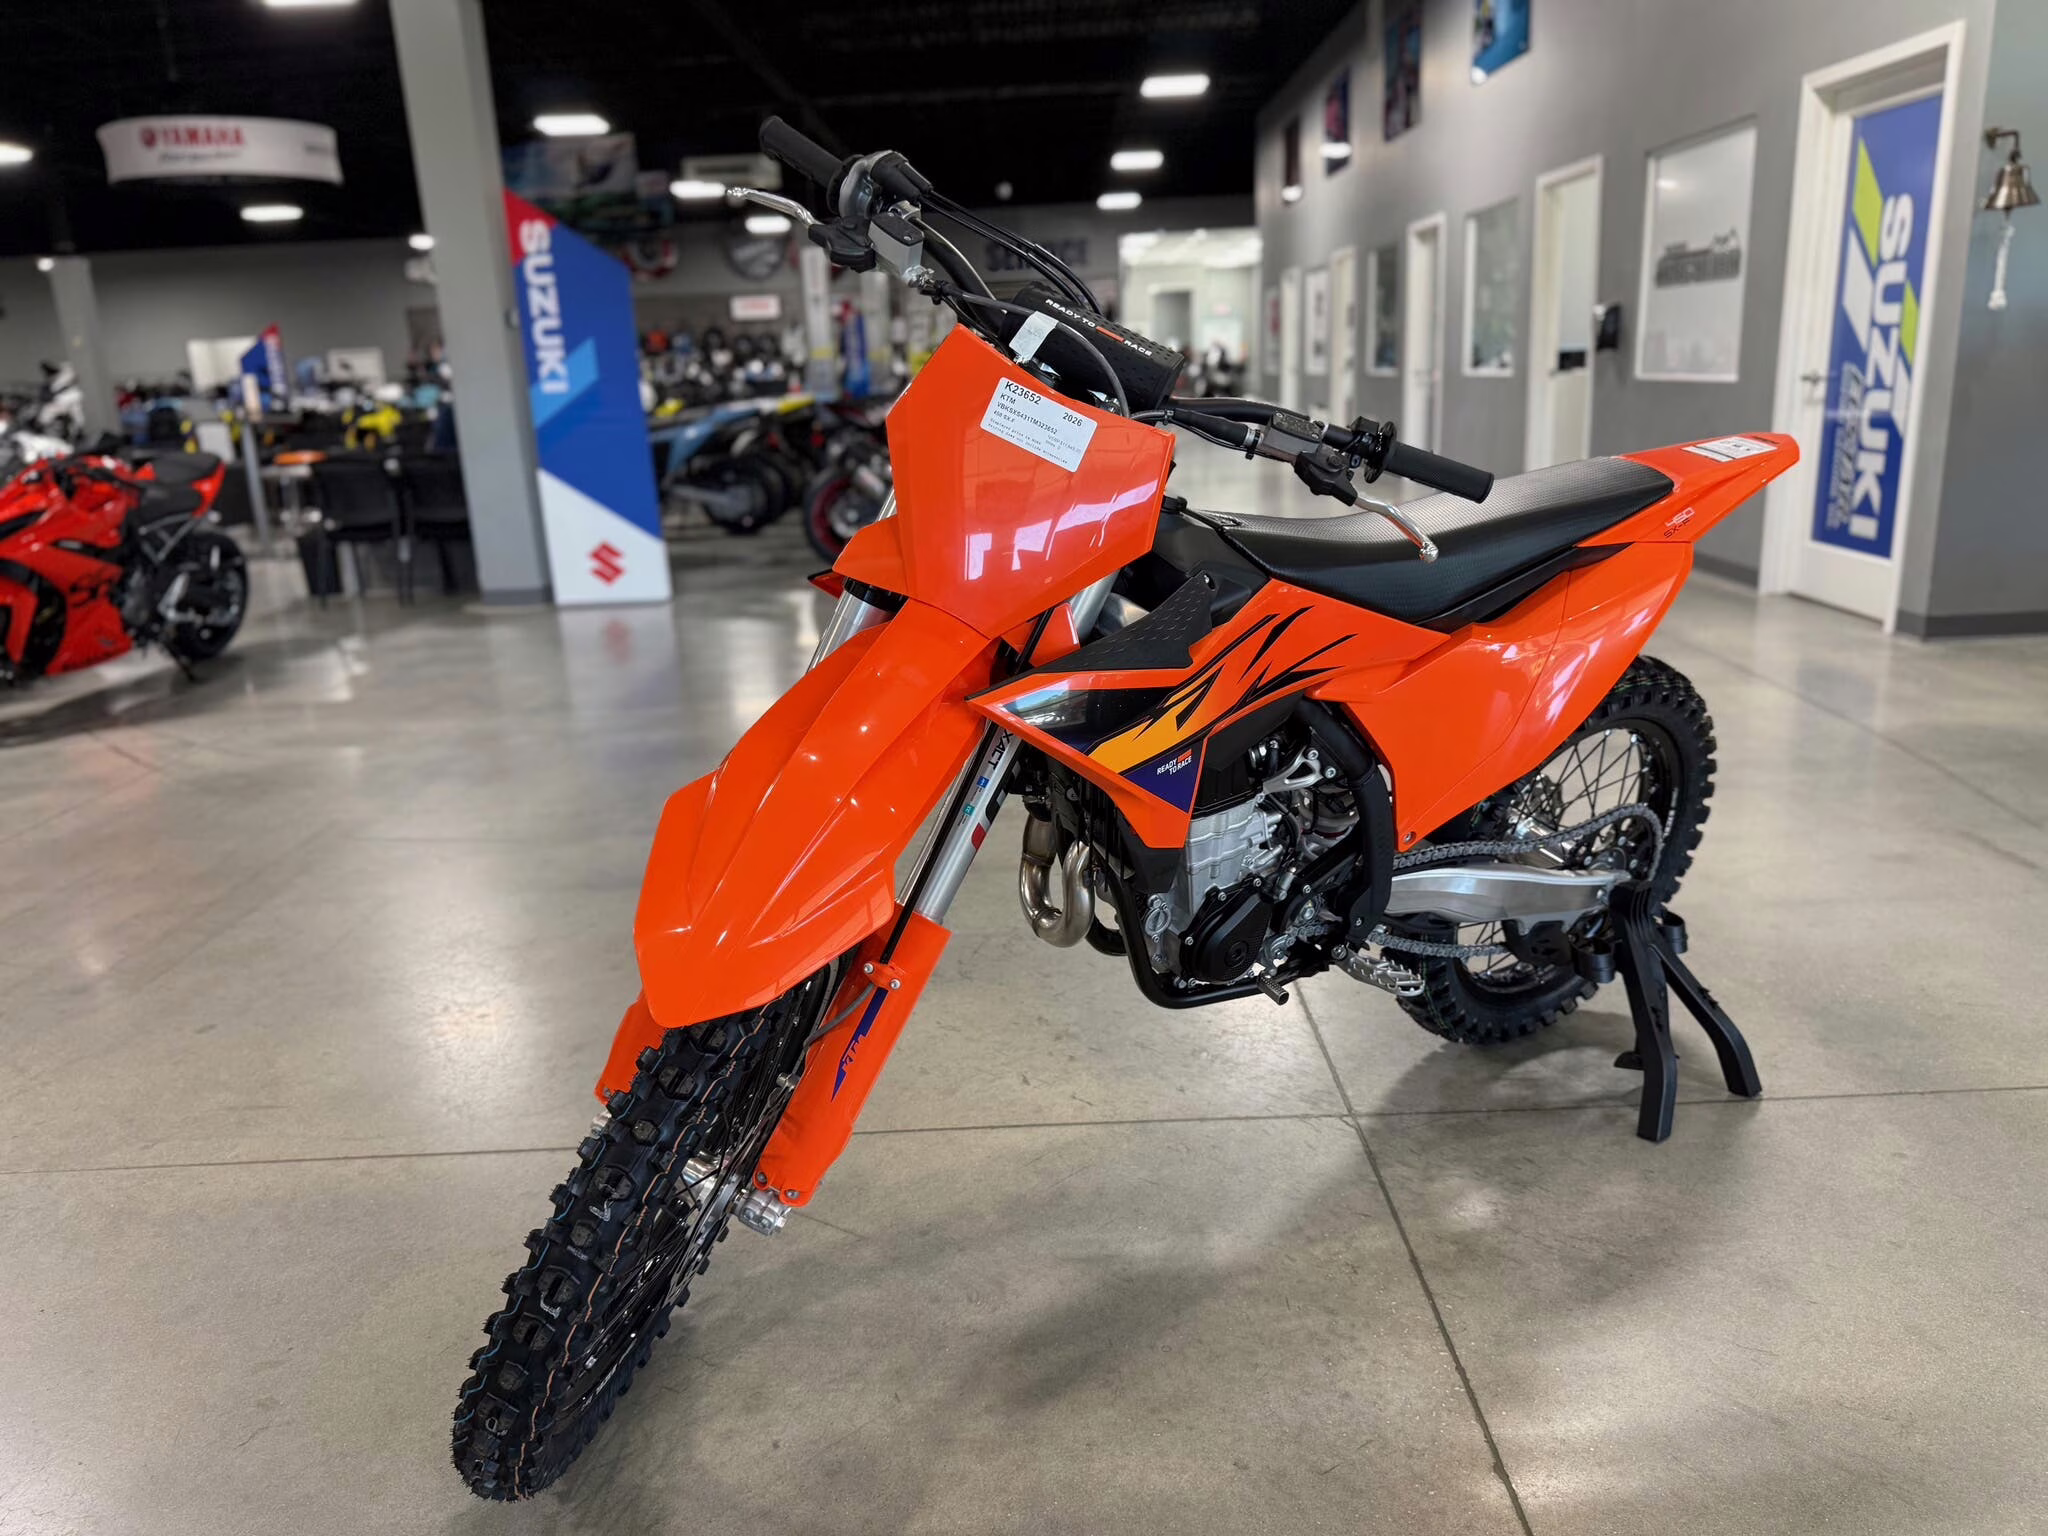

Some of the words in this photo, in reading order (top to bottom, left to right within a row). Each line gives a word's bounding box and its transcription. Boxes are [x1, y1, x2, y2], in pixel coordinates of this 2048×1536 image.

[161, 125, 246, 146] YAMAHA
[518, 219, 571, 394] SUZUKI
[1045, 298, 1081, 319] READY
[1082, 317, 1096, 328] TO
[1123, 339, 1153, 357] RACE
[1848, 193, 1915, 541] SUZUKI
[999, 392, 1016, 405] KTM
[1004, 380, 1042, 406] K23652
[1062, 411, 1083, 428] 2026
[1663, 517, 1691, 539] SX-F
[1156, 757, 1178, 776] READY
[1169, 765, 1177, 775] TO
[1177, 755, 1192, 770] RACE
